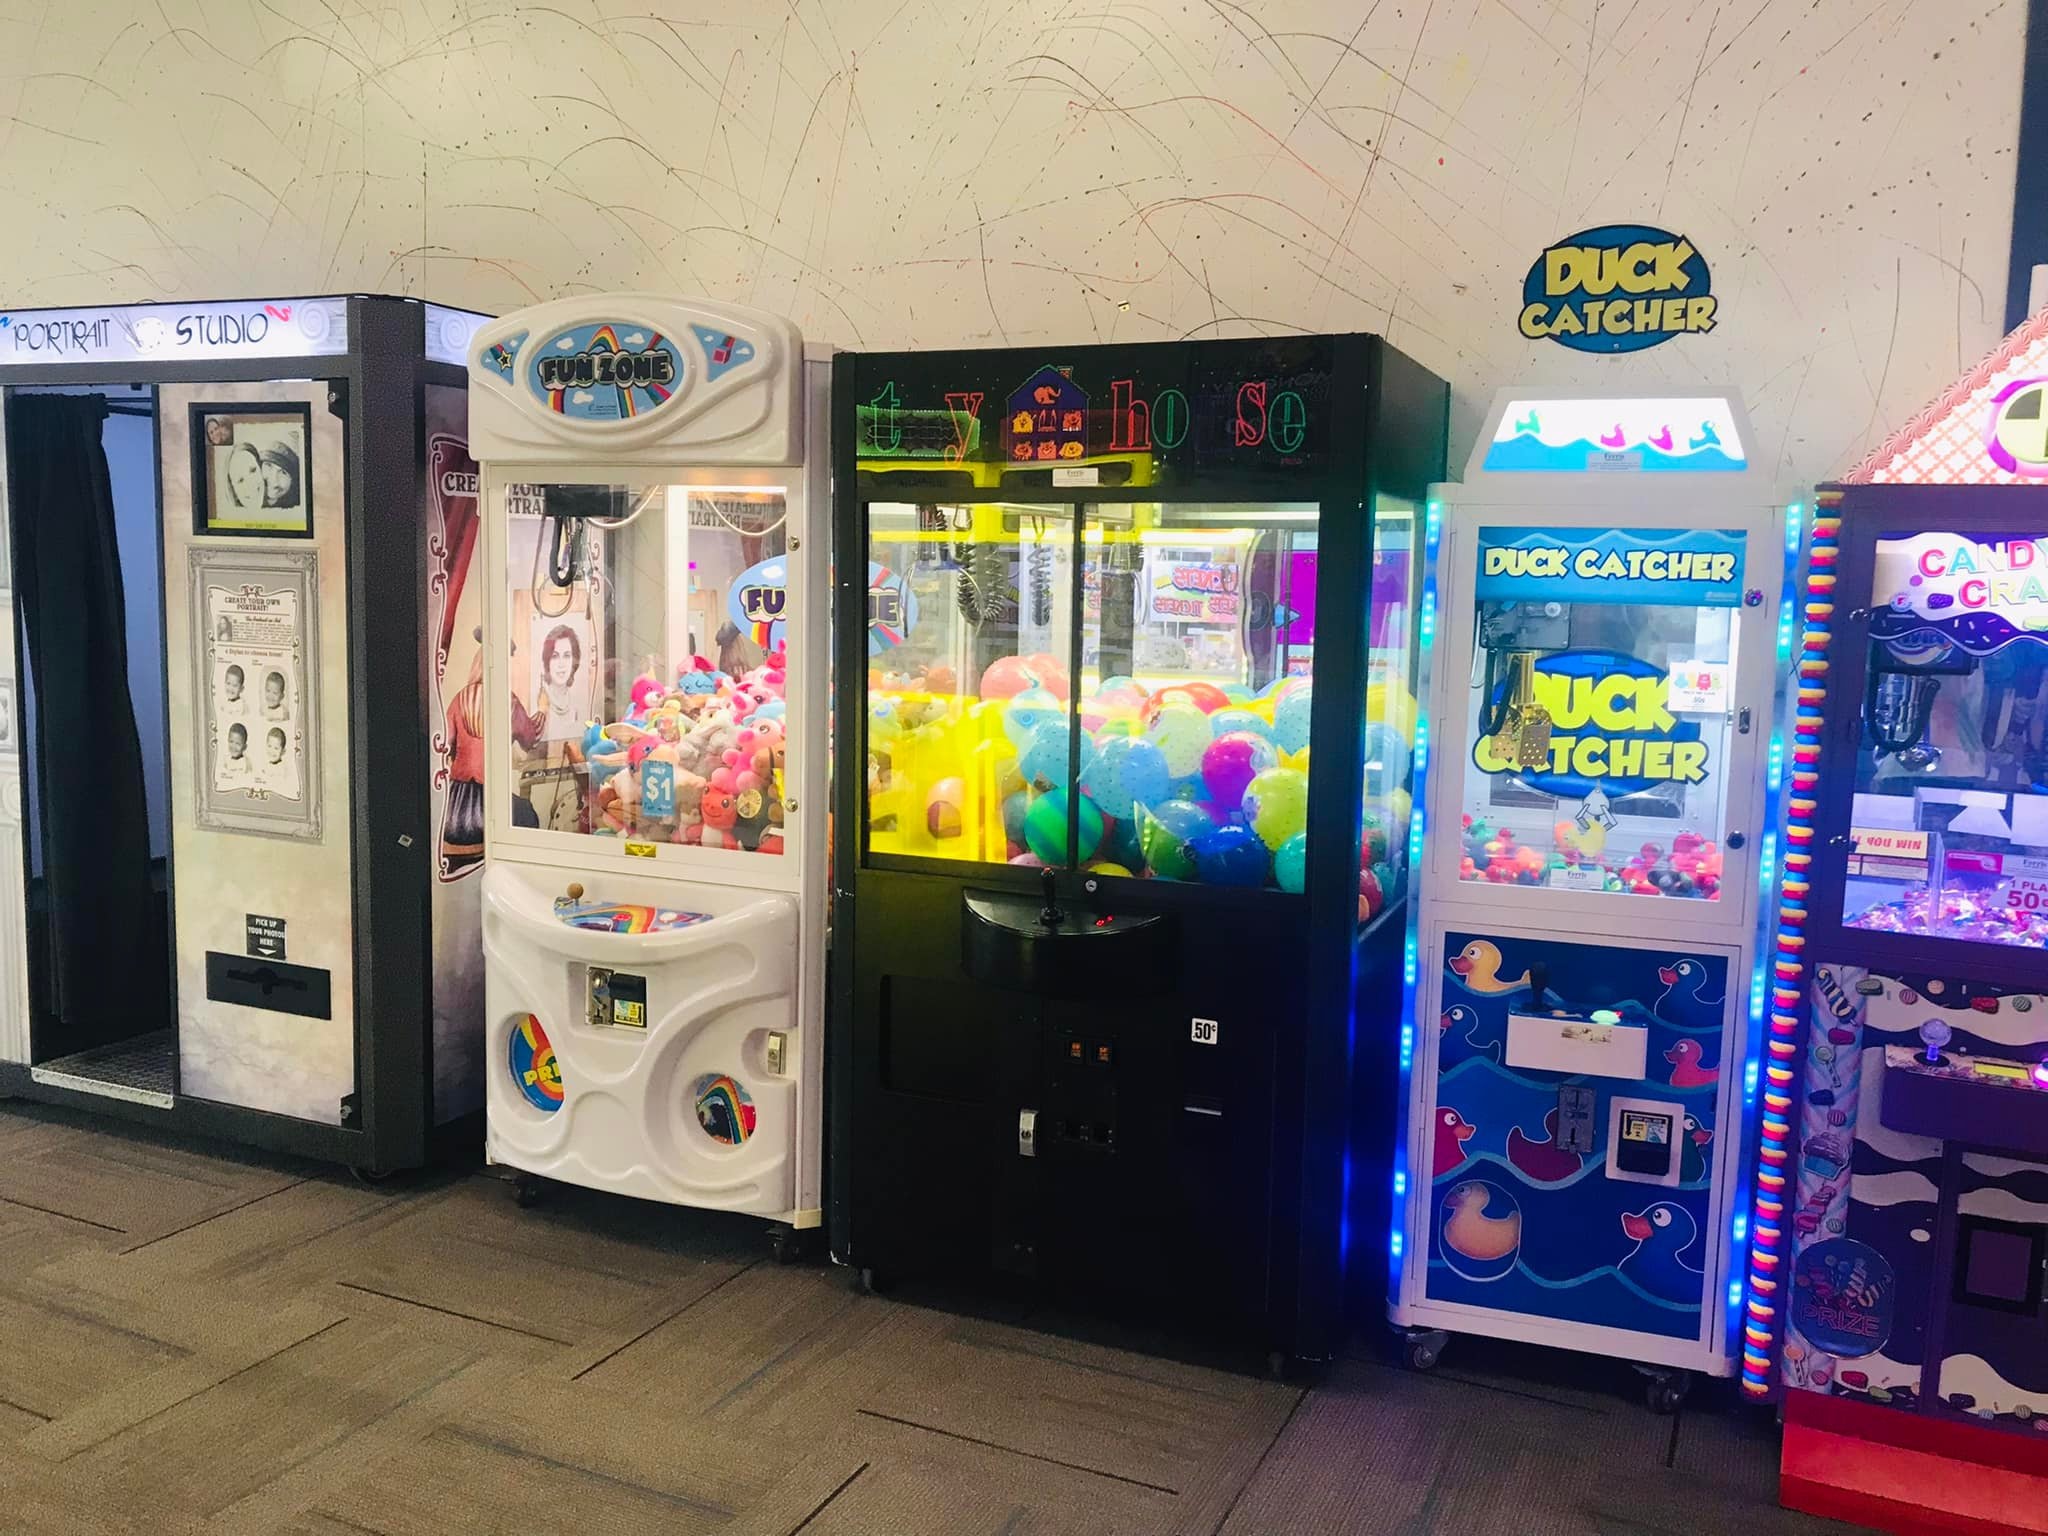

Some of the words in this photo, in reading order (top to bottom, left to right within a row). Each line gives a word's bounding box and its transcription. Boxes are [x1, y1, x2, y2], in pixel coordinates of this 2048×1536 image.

[1543, 238, 1695, 297] DUCK
[1519, 296, 1718, 338] CATCHER
[14, 319, 110, 354] PORTRAIT
[176, 313, 268, 345] STUDIO
[541, 356, 595, 383] FUN
[598, 354, 672, 384] ZONE
[445, 473, 480, 494] CRE
[513, 484, 545, 497] YOU
[1483, 547, 1570, 578] DUCK
[1574, 548, 1737, 583] CATCHER
[225, 596, 247, 604] CREATE
[747, 589, 786, 615] FU
[646, 775, 671, 803] $1
[1896, 838, 1922, 851] WIN
[2010, 879, 2016, 888] 1
[248, 926, 262, 935] YOUR
[256, 918, 268, 926] PICK
[269, 919, 277, 928] UP
[260, 938, 273, 946] HERE
[1801, 1304, 1880, 1338] PRIZE
